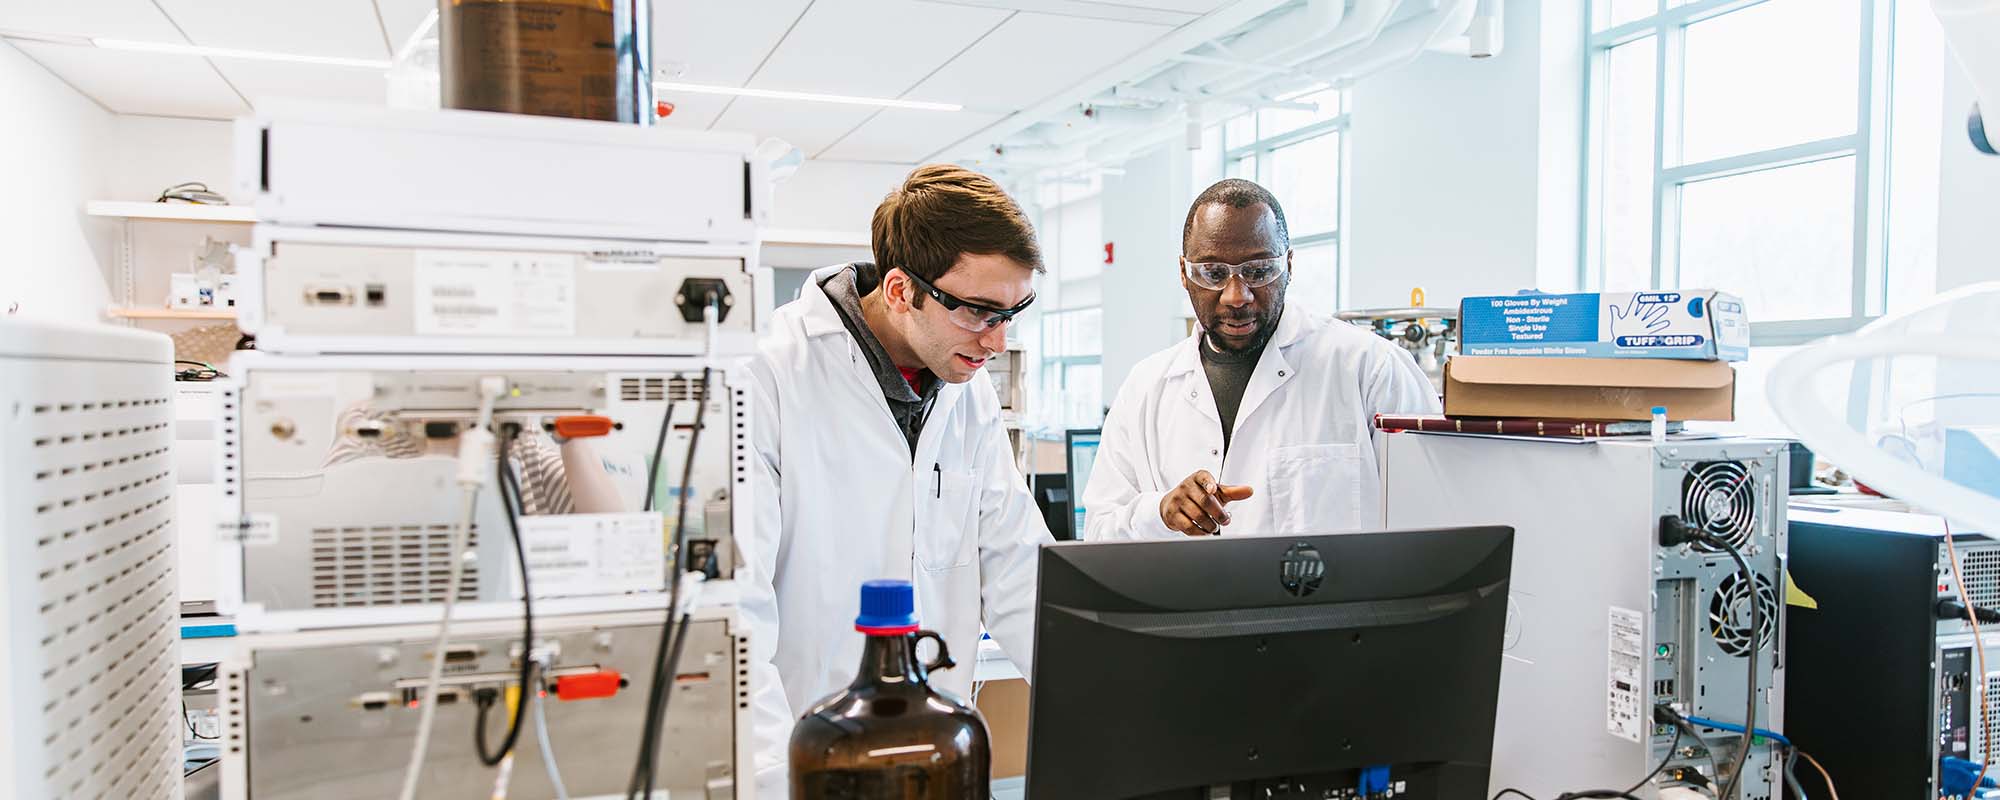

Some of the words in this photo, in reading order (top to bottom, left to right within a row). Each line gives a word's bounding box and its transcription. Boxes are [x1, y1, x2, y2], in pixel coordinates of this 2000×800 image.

[1504, 299, 1529, 307] Gloves
[1530, 299, 1541, 308] By
[1542, 298, 1568, 307] Weight
[1503, 307, 1553, 315] Ambidextrous
[1506, 316, 1521, 324] Non
[1526, 315, 1550, 323] Sterile
[1508, 324, 1531, 333] Single
[1532, 324, 1547, 332] Use
[1511, 332, 1544, 340] Textured
[1624, 336, 1656, 346] TUFF
[1664, 336, 1696, 346] GRIP
